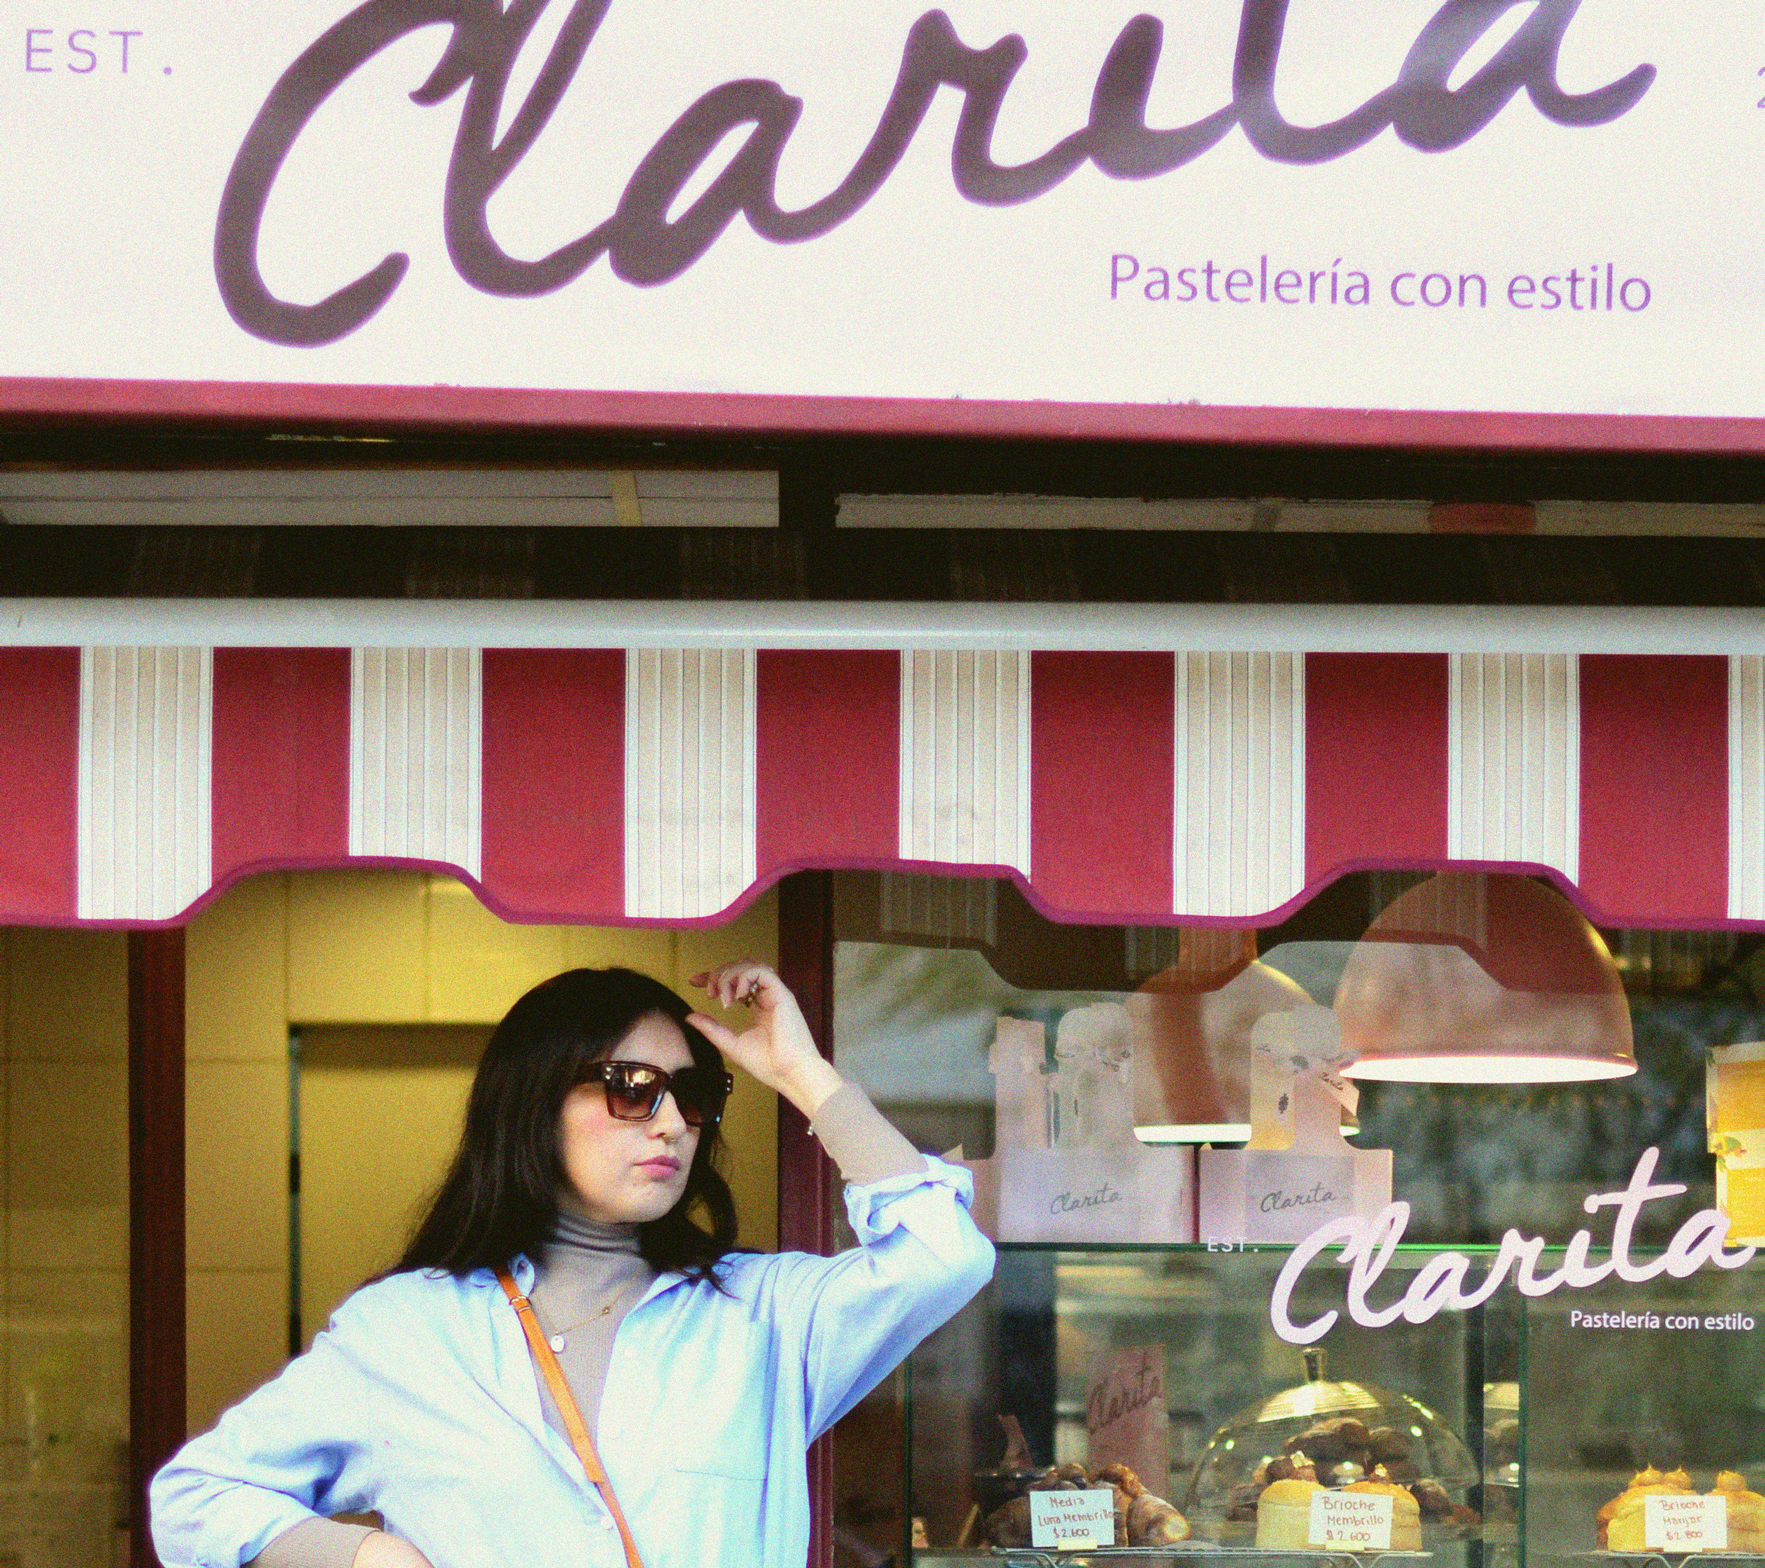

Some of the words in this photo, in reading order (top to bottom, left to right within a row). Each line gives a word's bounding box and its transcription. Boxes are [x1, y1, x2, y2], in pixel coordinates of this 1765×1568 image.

[25, 28, 173, 76] EST.
[1110, 252, 1371, 307] Pastelería
[1390, 271, 1488, 309] con
[1507, 262, 1652, 313] estilo
[1050, 1182, 1122, 1215] Clarita
[1260, 1182, 1336, 1213] Clarita
[1207, 1236, 1259, 1252] EST.
[1271, 1147, 1756, 1344] Clarita
[1570, 1310, 1660, 1329] Pastelería
[1665, 1315, 1700, 1330] con
[1704, 1312, 1755, 1331] estilo
[1049, 1497, 1085, 1508] Media
[1321, 1496, 1375, 1511] Brioche
[1038, 1515, 1061, 1526] Luna
[1327, 1515, 1384, 1526] Membrillo
